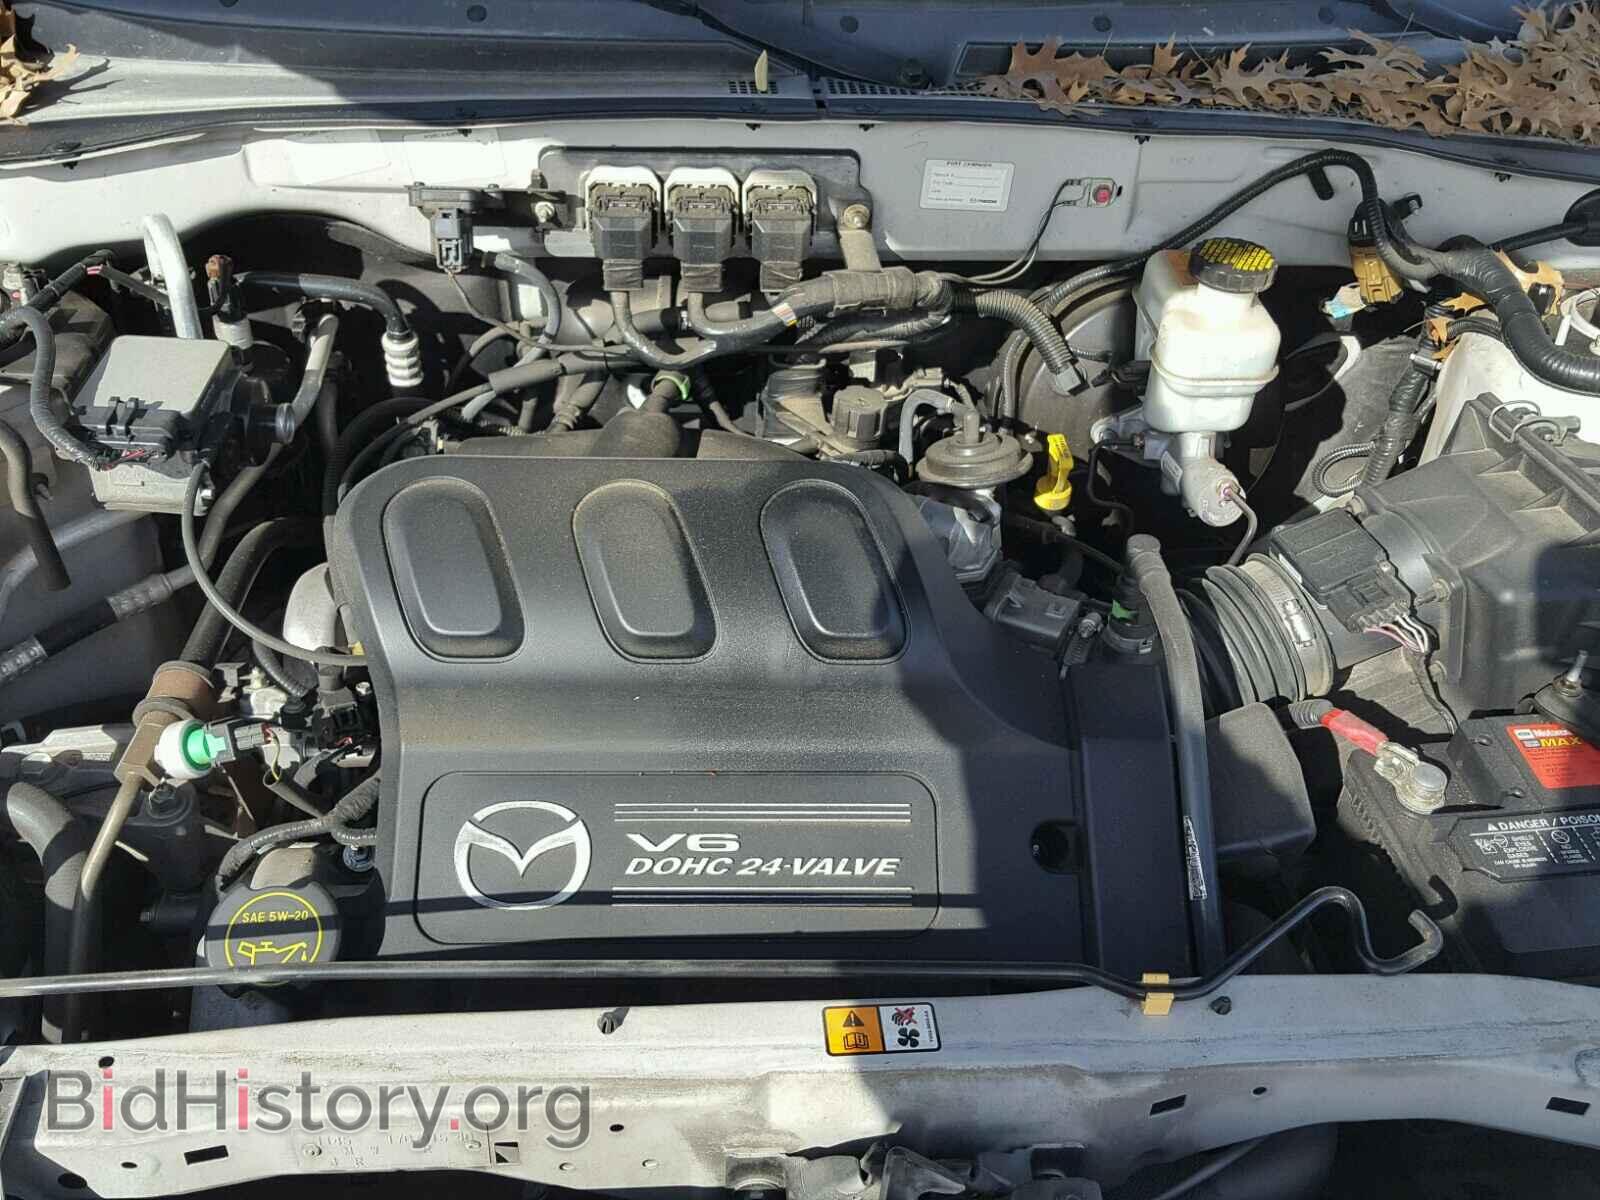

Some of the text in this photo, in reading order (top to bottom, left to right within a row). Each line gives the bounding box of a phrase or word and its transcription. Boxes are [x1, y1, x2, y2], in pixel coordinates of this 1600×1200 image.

[1540, 737, 1582, 747] MAX
[1497, 818, 1550, 831] DANGER
[625, 833, 741, 852] V6
[625, 857, 901, 876] DOHC 24-VALVE
[242, 911, 309, 923] SAE 5W-20
